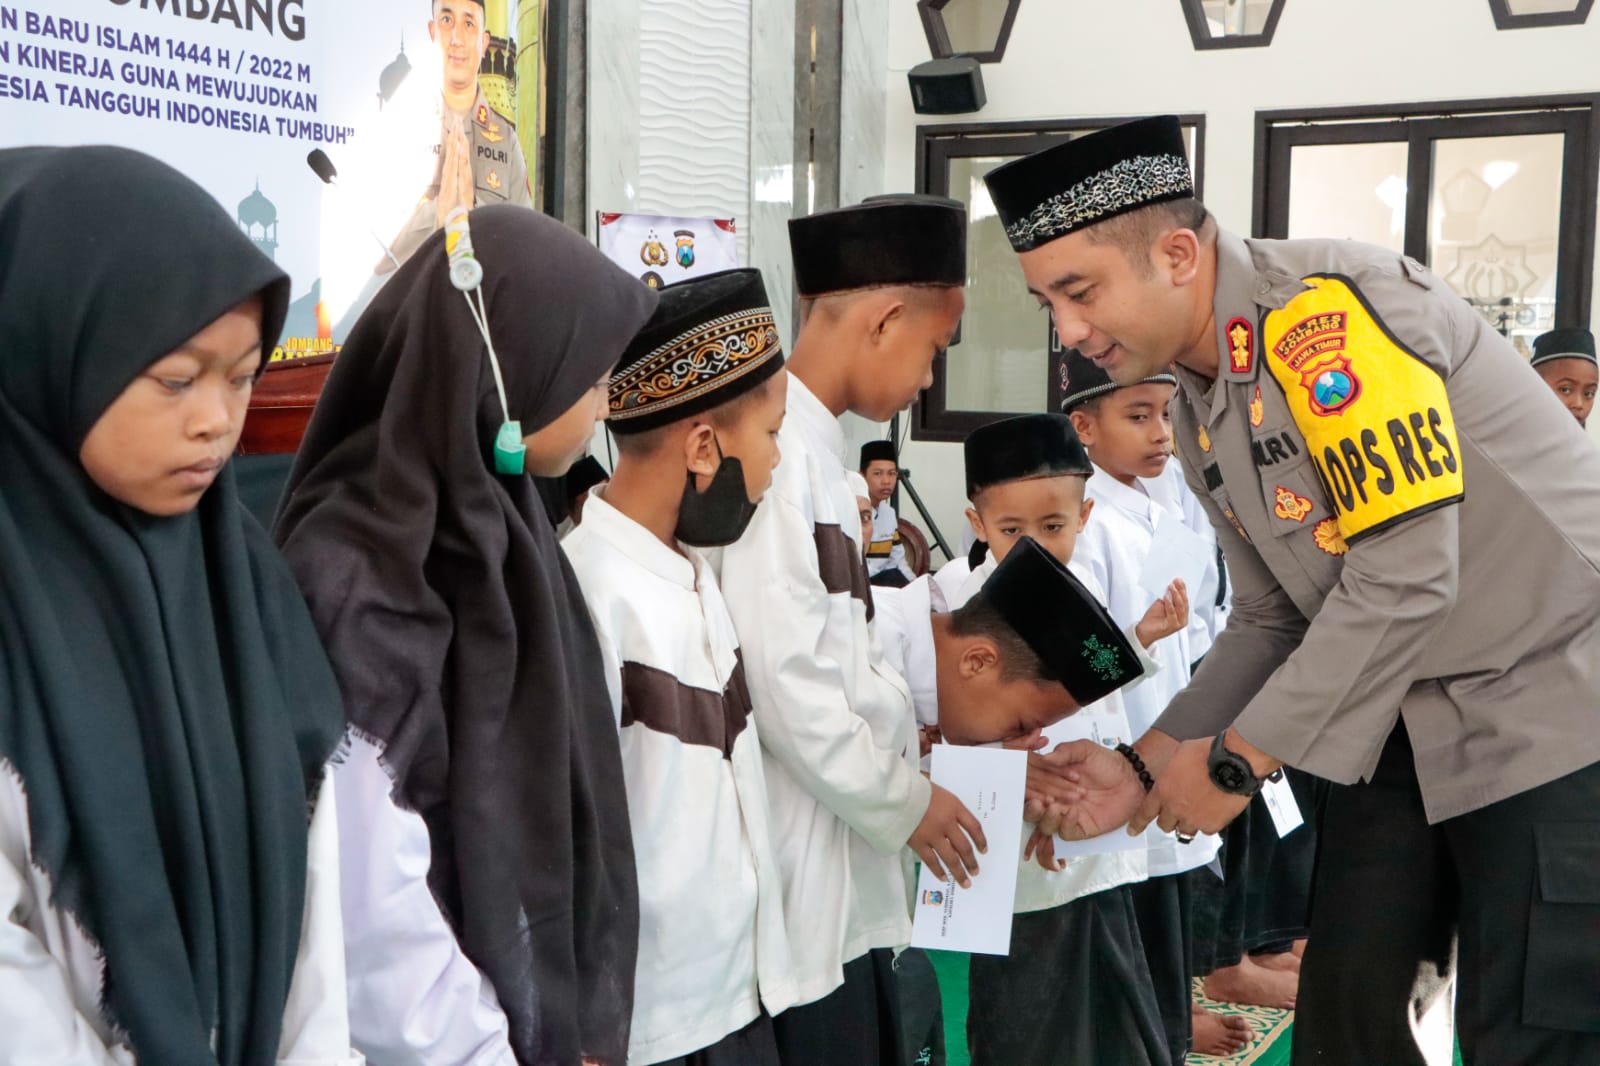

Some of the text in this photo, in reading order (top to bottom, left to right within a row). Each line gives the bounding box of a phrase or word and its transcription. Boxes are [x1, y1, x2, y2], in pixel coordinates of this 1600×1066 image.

[25, 11, 90, 44] BARU
[96, 25, 160, 57] ISLAM
[166, 38, 212, 66] 1444
[217, 48, 230, 69] H
[235, 50, 245, 75] /
[249, 54, 293, 80] 2022
[297, 62, 311, 84] M
[17, 43, 114, 81] KINERJA
[120, 62, 180, 91] GUNA
[186, 73, 318, 113] MEWUJUDKAN
[55, 83, 160, 119] TANGGUH
[167, 100, 271, 135] INDONESIA
[477, 145, 508, 164] POLRI
[1278, 314, 1342, 352] POLRES
[1283, 320, 1340, 355] JOMBANG
[1294, 338, 1342, 368] JAWA TIMUR
[1386, 407, 1457, 485] RES
